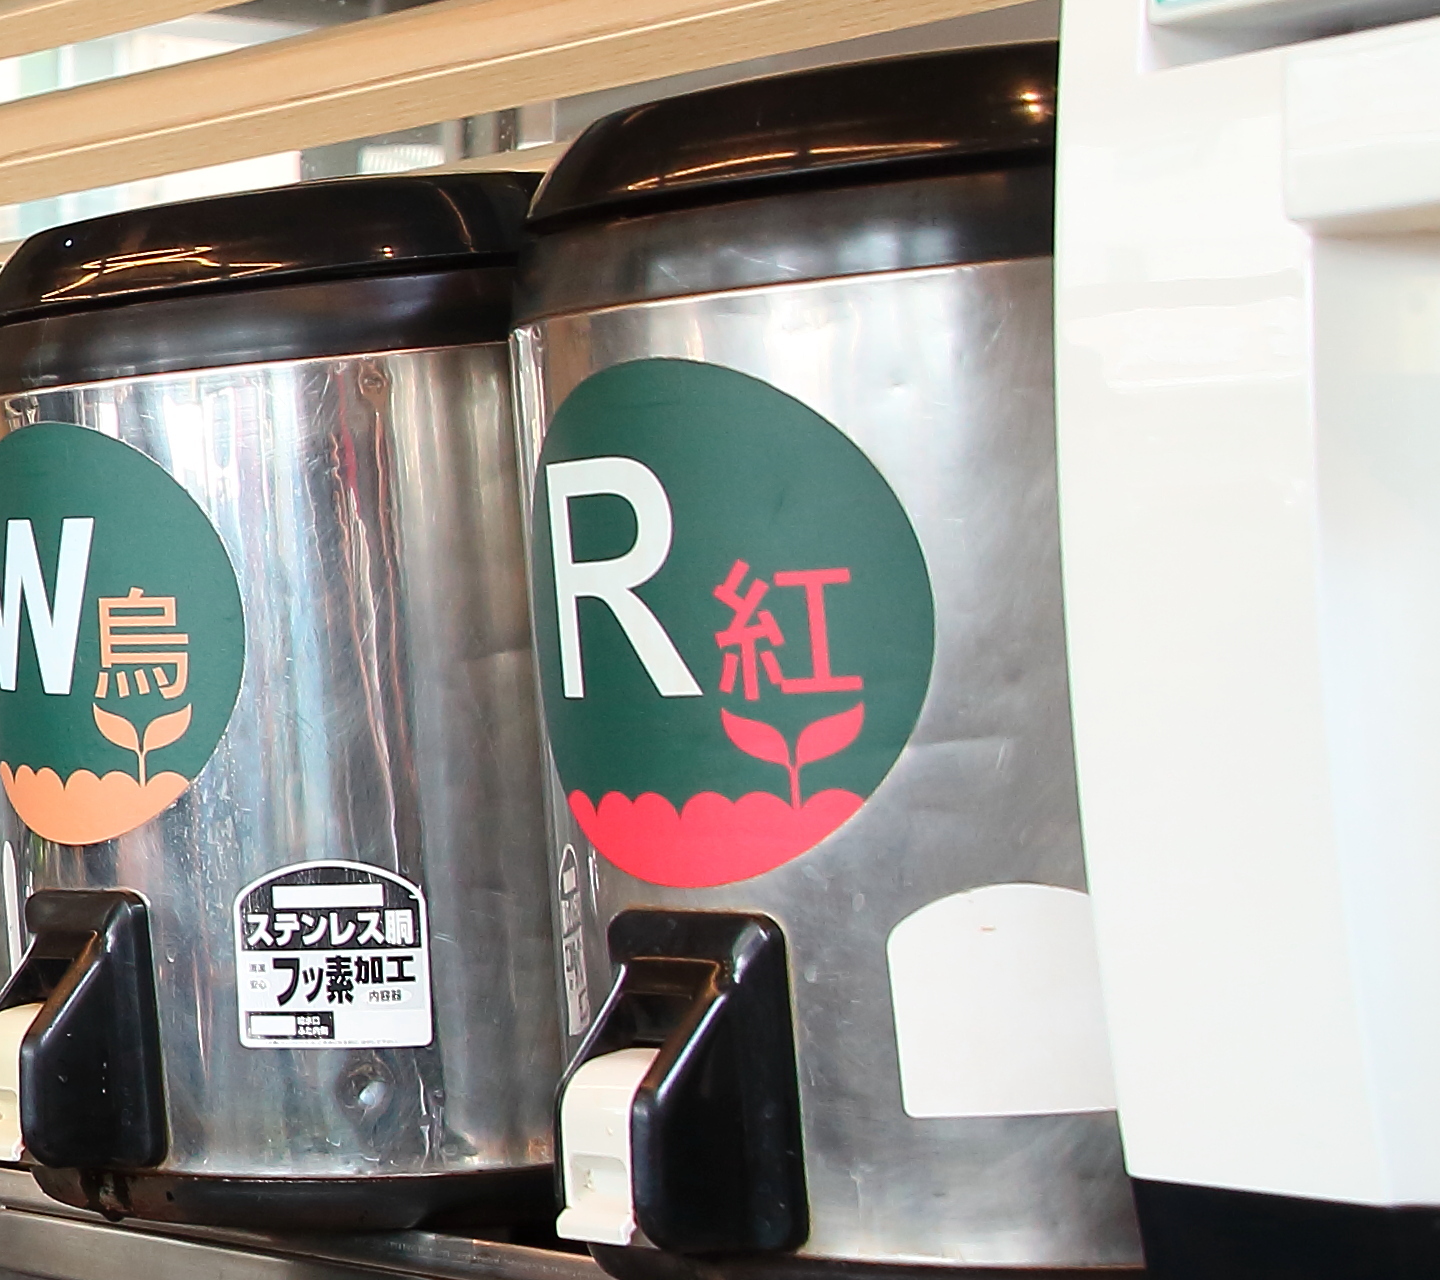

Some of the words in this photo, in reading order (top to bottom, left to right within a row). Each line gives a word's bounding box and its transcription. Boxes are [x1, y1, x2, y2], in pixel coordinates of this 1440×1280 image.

[544, 455, 704, 699] R
[713, 558, 864, 702] 紅
[95, 586, 189, 699] 烏
[272, 956, 416, 1007] フッ素加工
